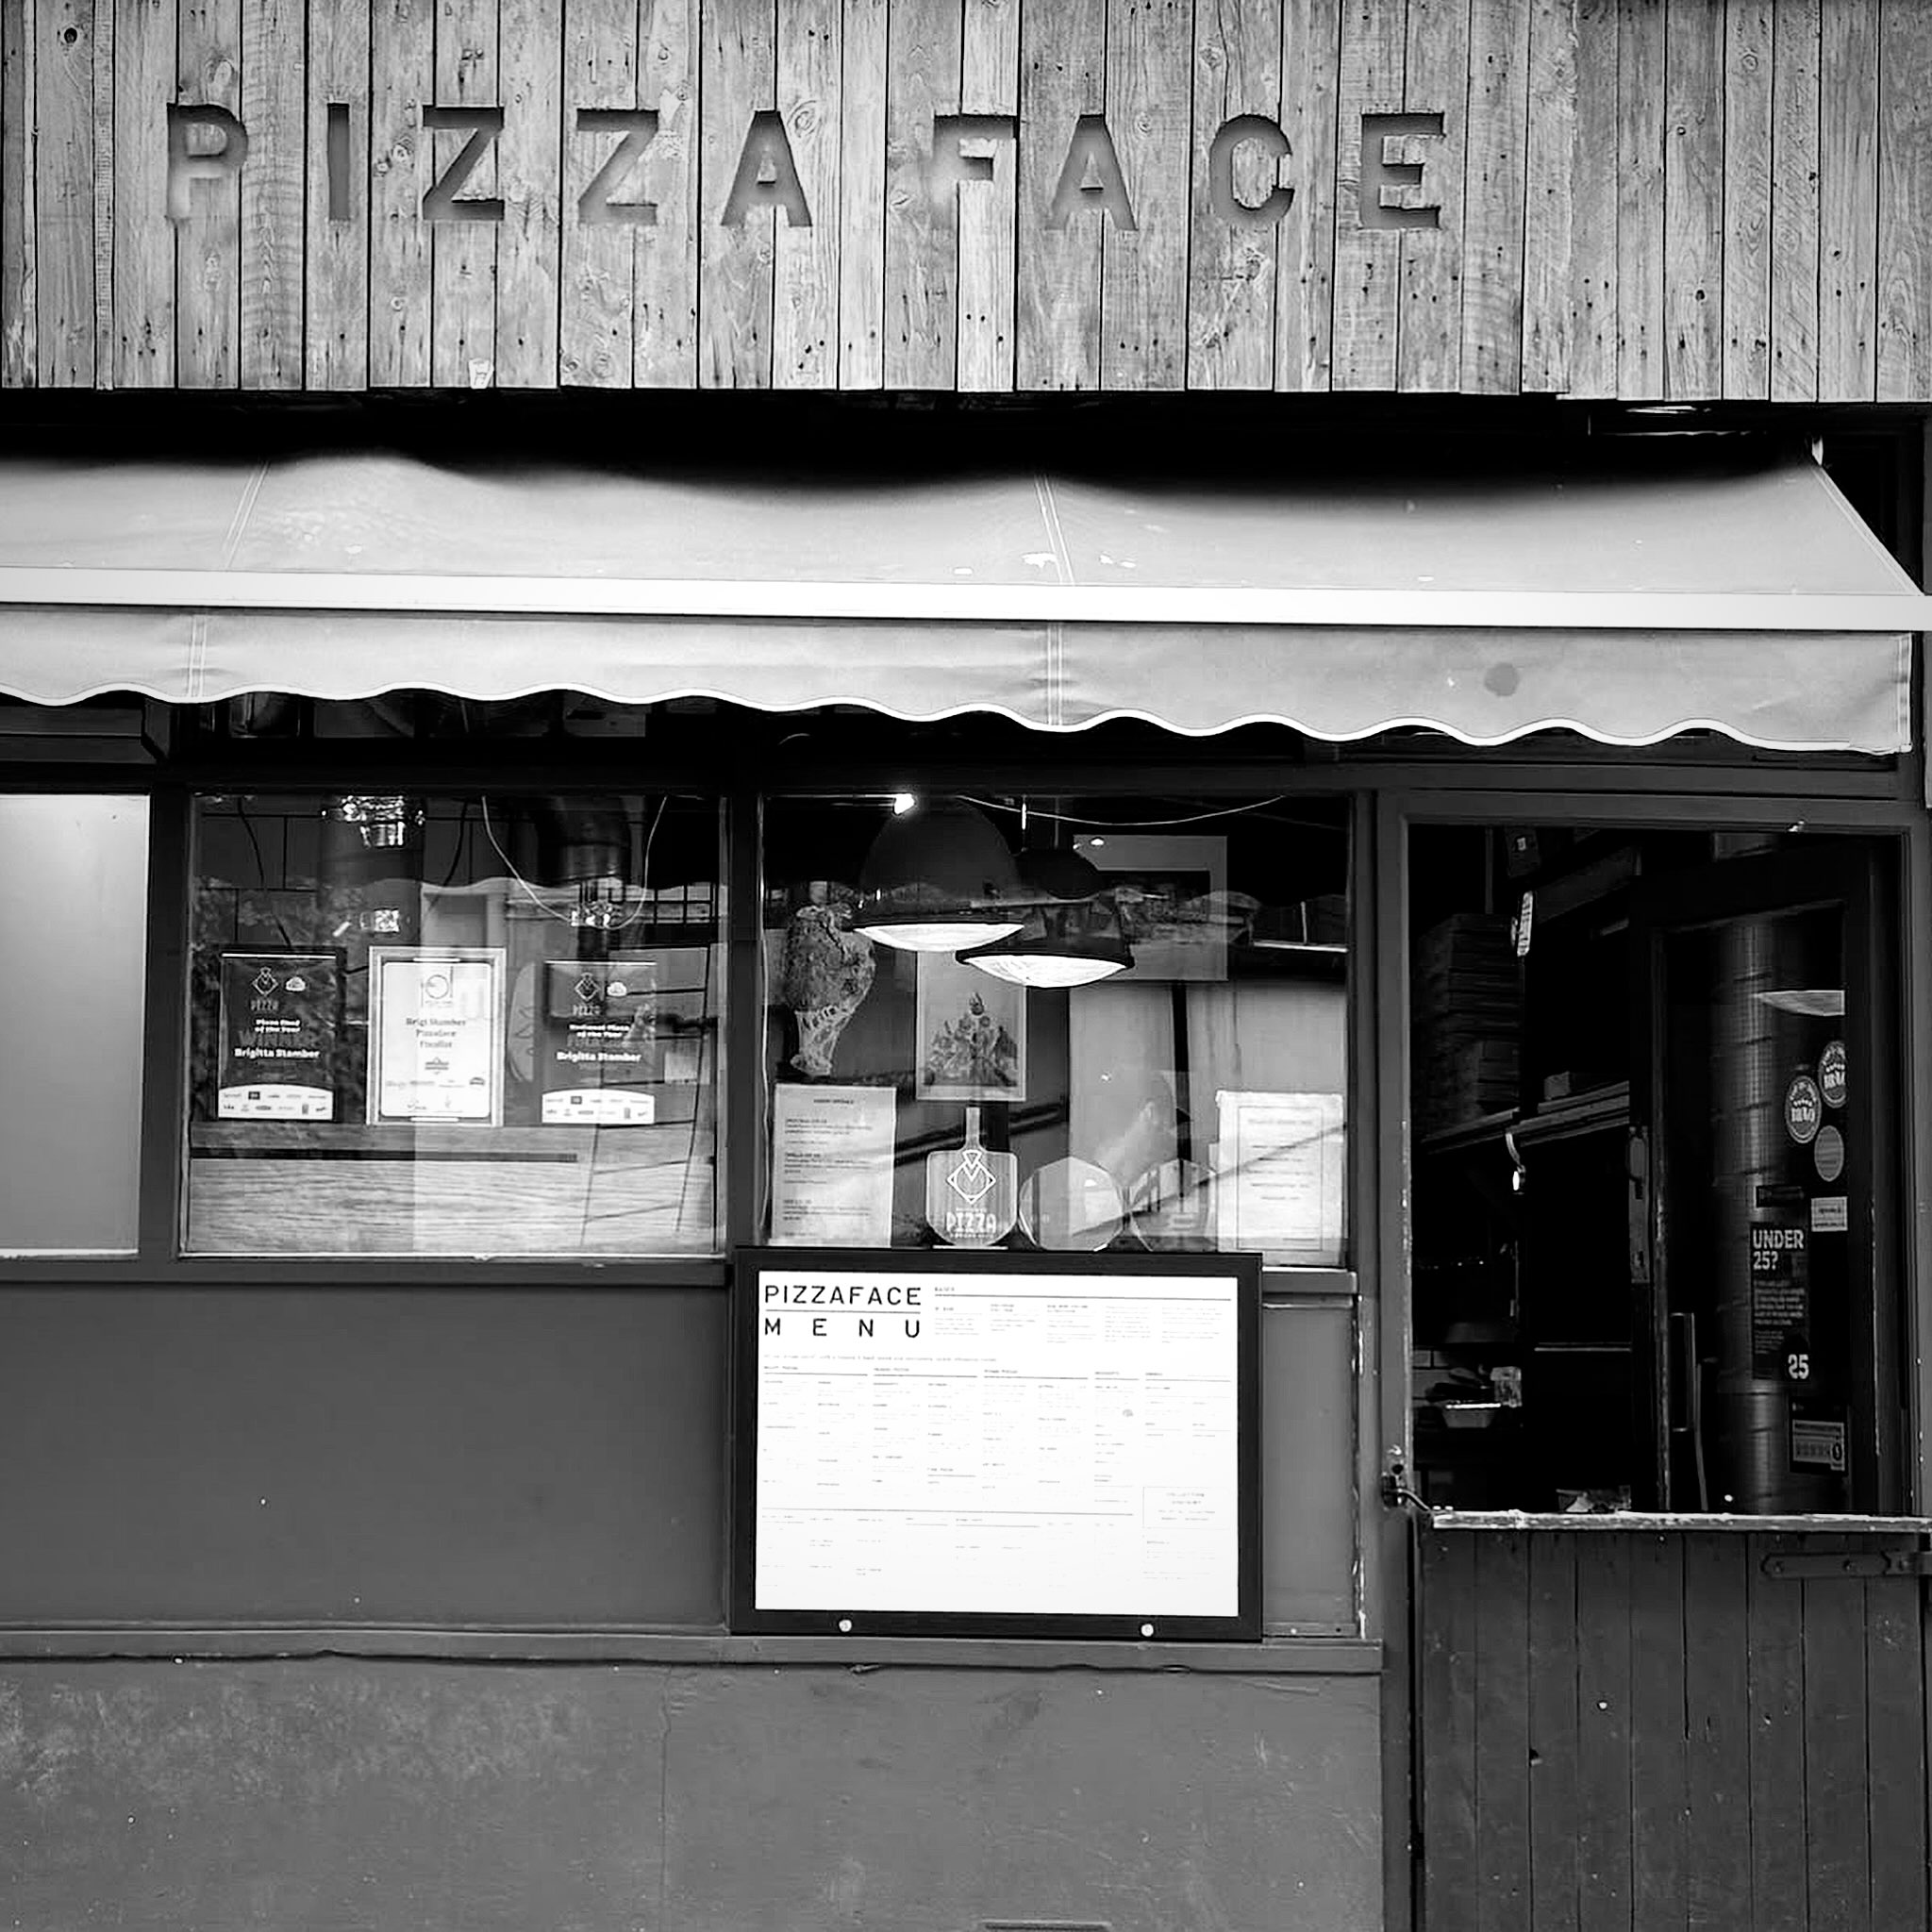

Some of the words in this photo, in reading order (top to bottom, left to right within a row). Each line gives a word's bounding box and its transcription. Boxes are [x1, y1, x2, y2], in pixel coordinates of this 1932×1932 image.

[167, 102, 811, 227] PIZZA
[930, 112, 1445, 230] FACE
[234, 1048, 275, 1059] Brigitta
[275, 1049, 321, 1059] Stamber
[556, 1051, 596, 1063] Brigitta
[597, 1052, 641, 1062] Stamber
[945, 1211, 997, 1234] PIZZA
[1753, 1229, 1804, 1249] UNDER
[1753, 1250, 1778, 1270] 25?
[764, 1285, 922, 1306] PIZZAFACE
[764, 1317, 921, 1338] MENU
[1788, 1354, 1809, 1379] 25
